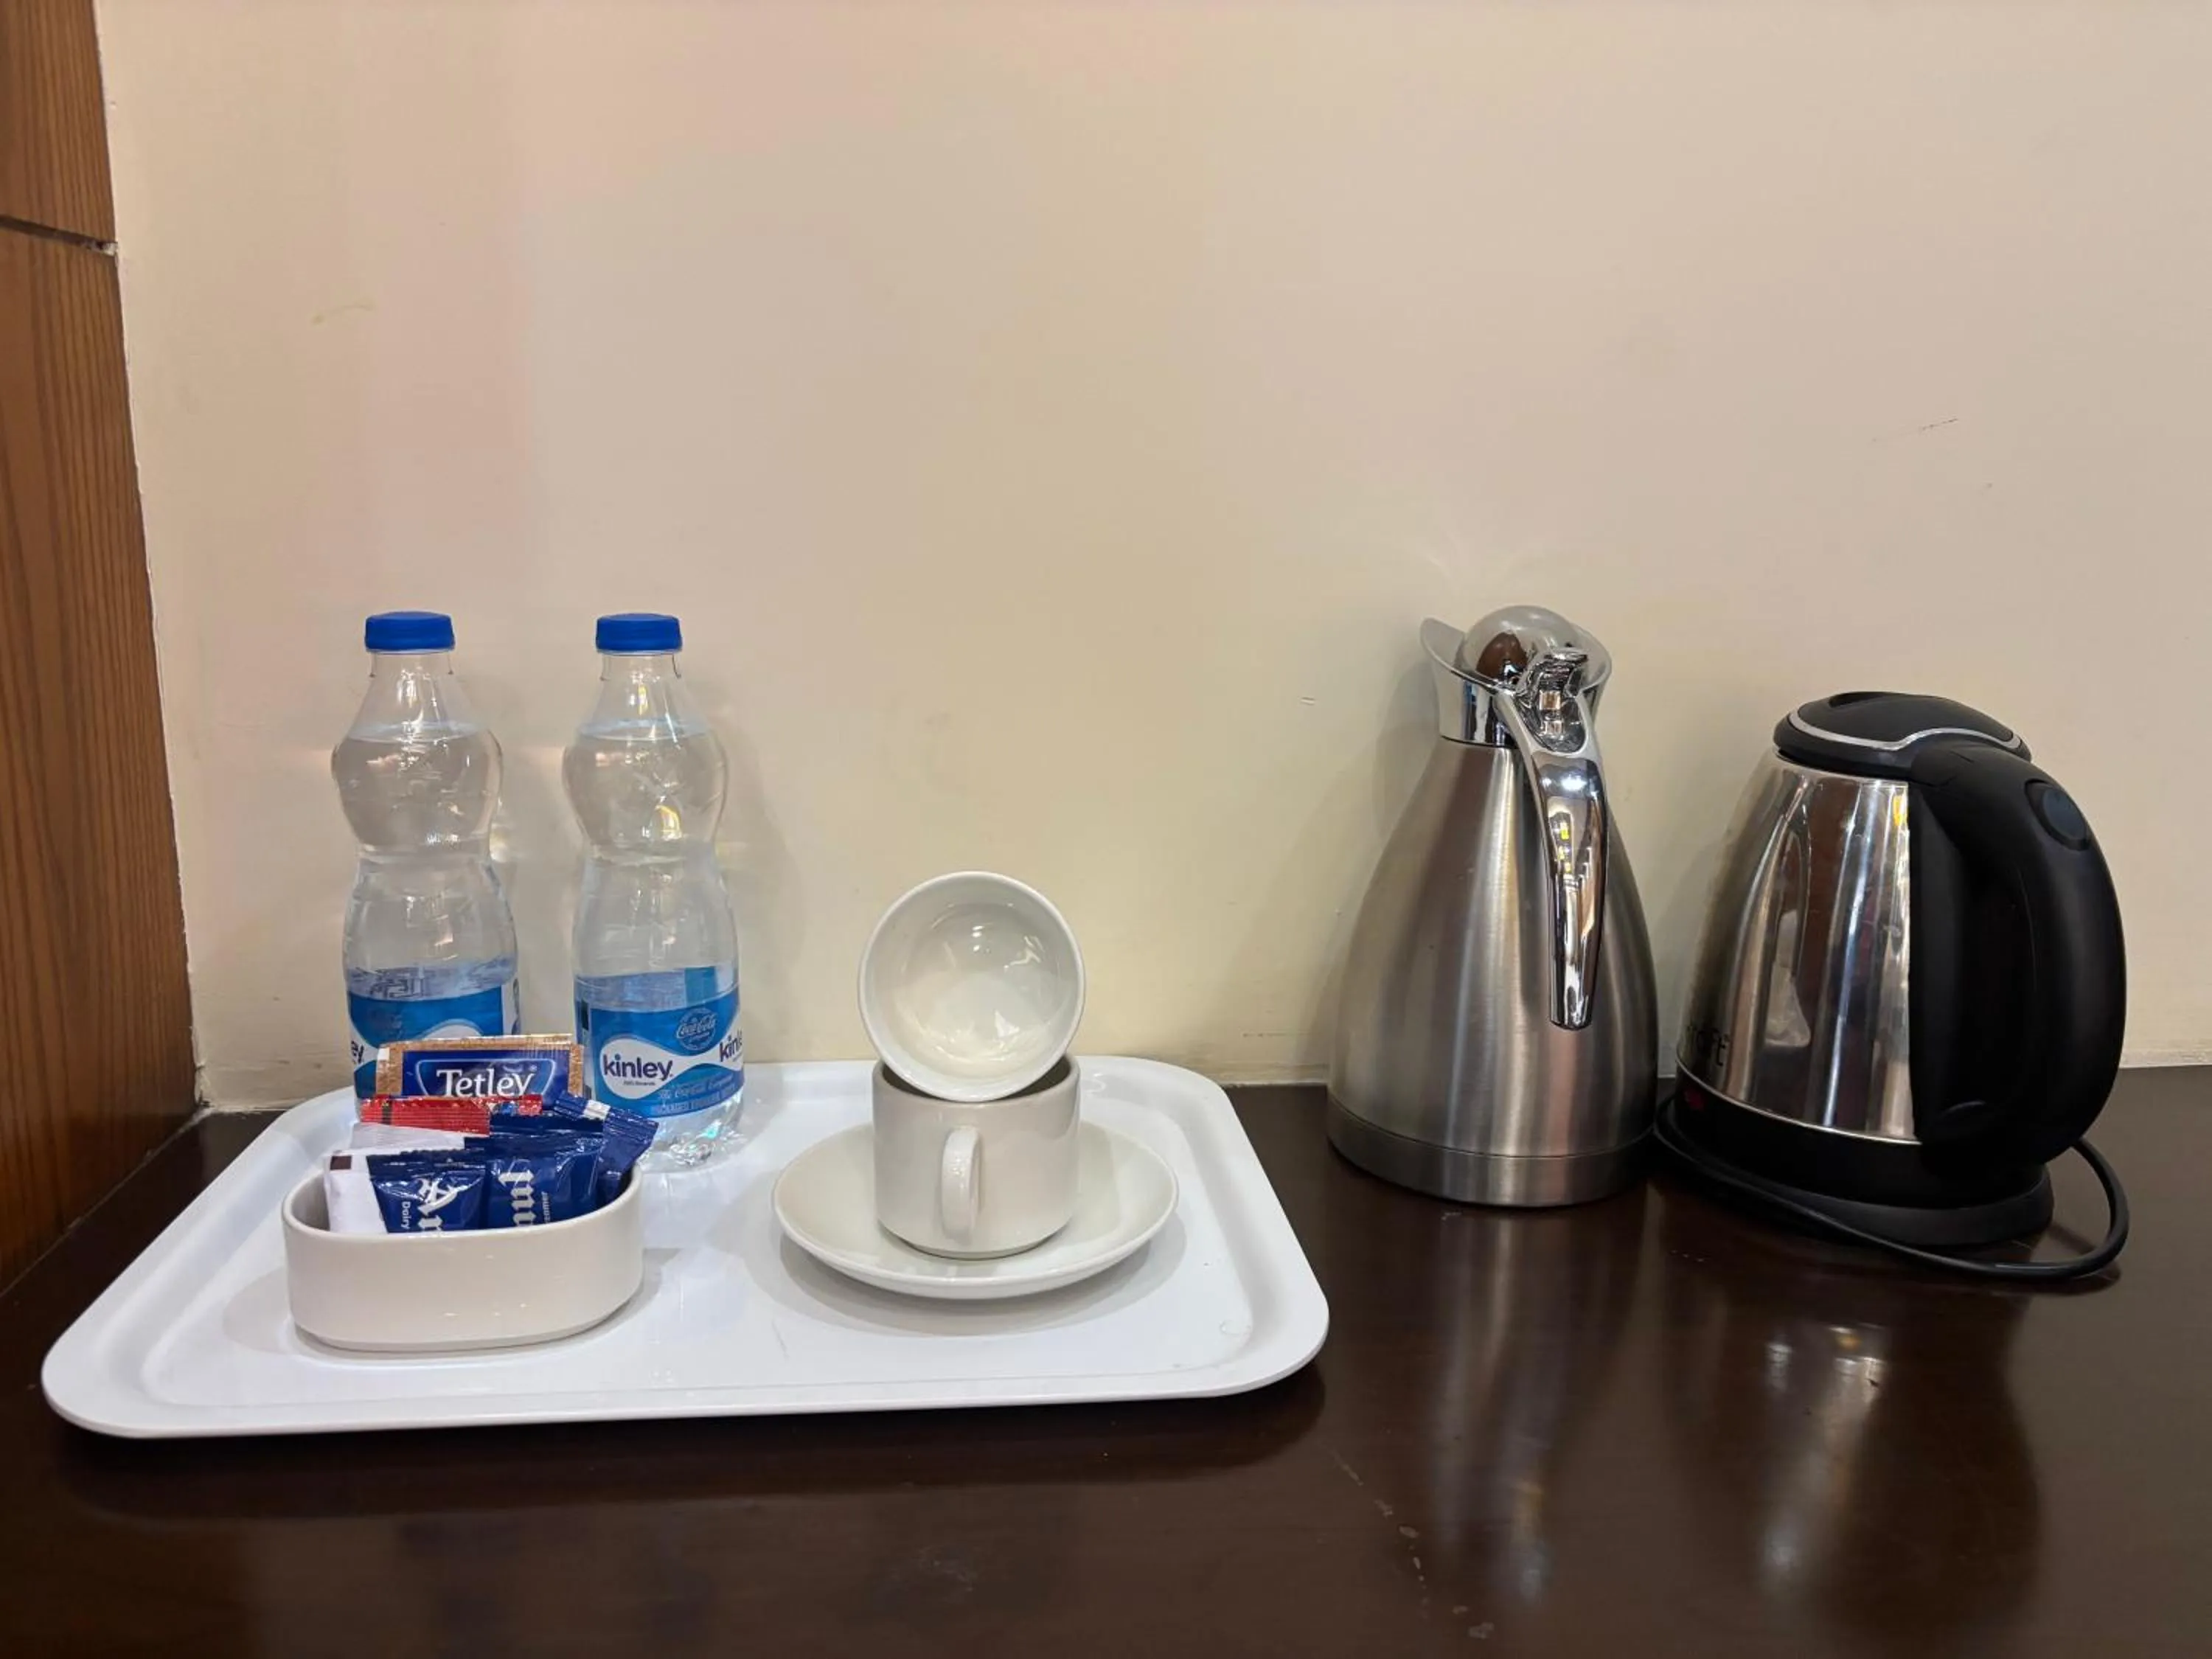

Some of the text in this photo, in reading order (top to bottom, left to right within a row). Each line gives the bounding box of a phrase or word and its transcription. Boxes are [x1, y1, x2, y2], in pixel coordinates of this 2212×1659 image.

[602, 1054, 673, 1081] kinley
[436, 1068, 535, 1097] Tetley
[401, 1200, 411, 1230] Dairy
